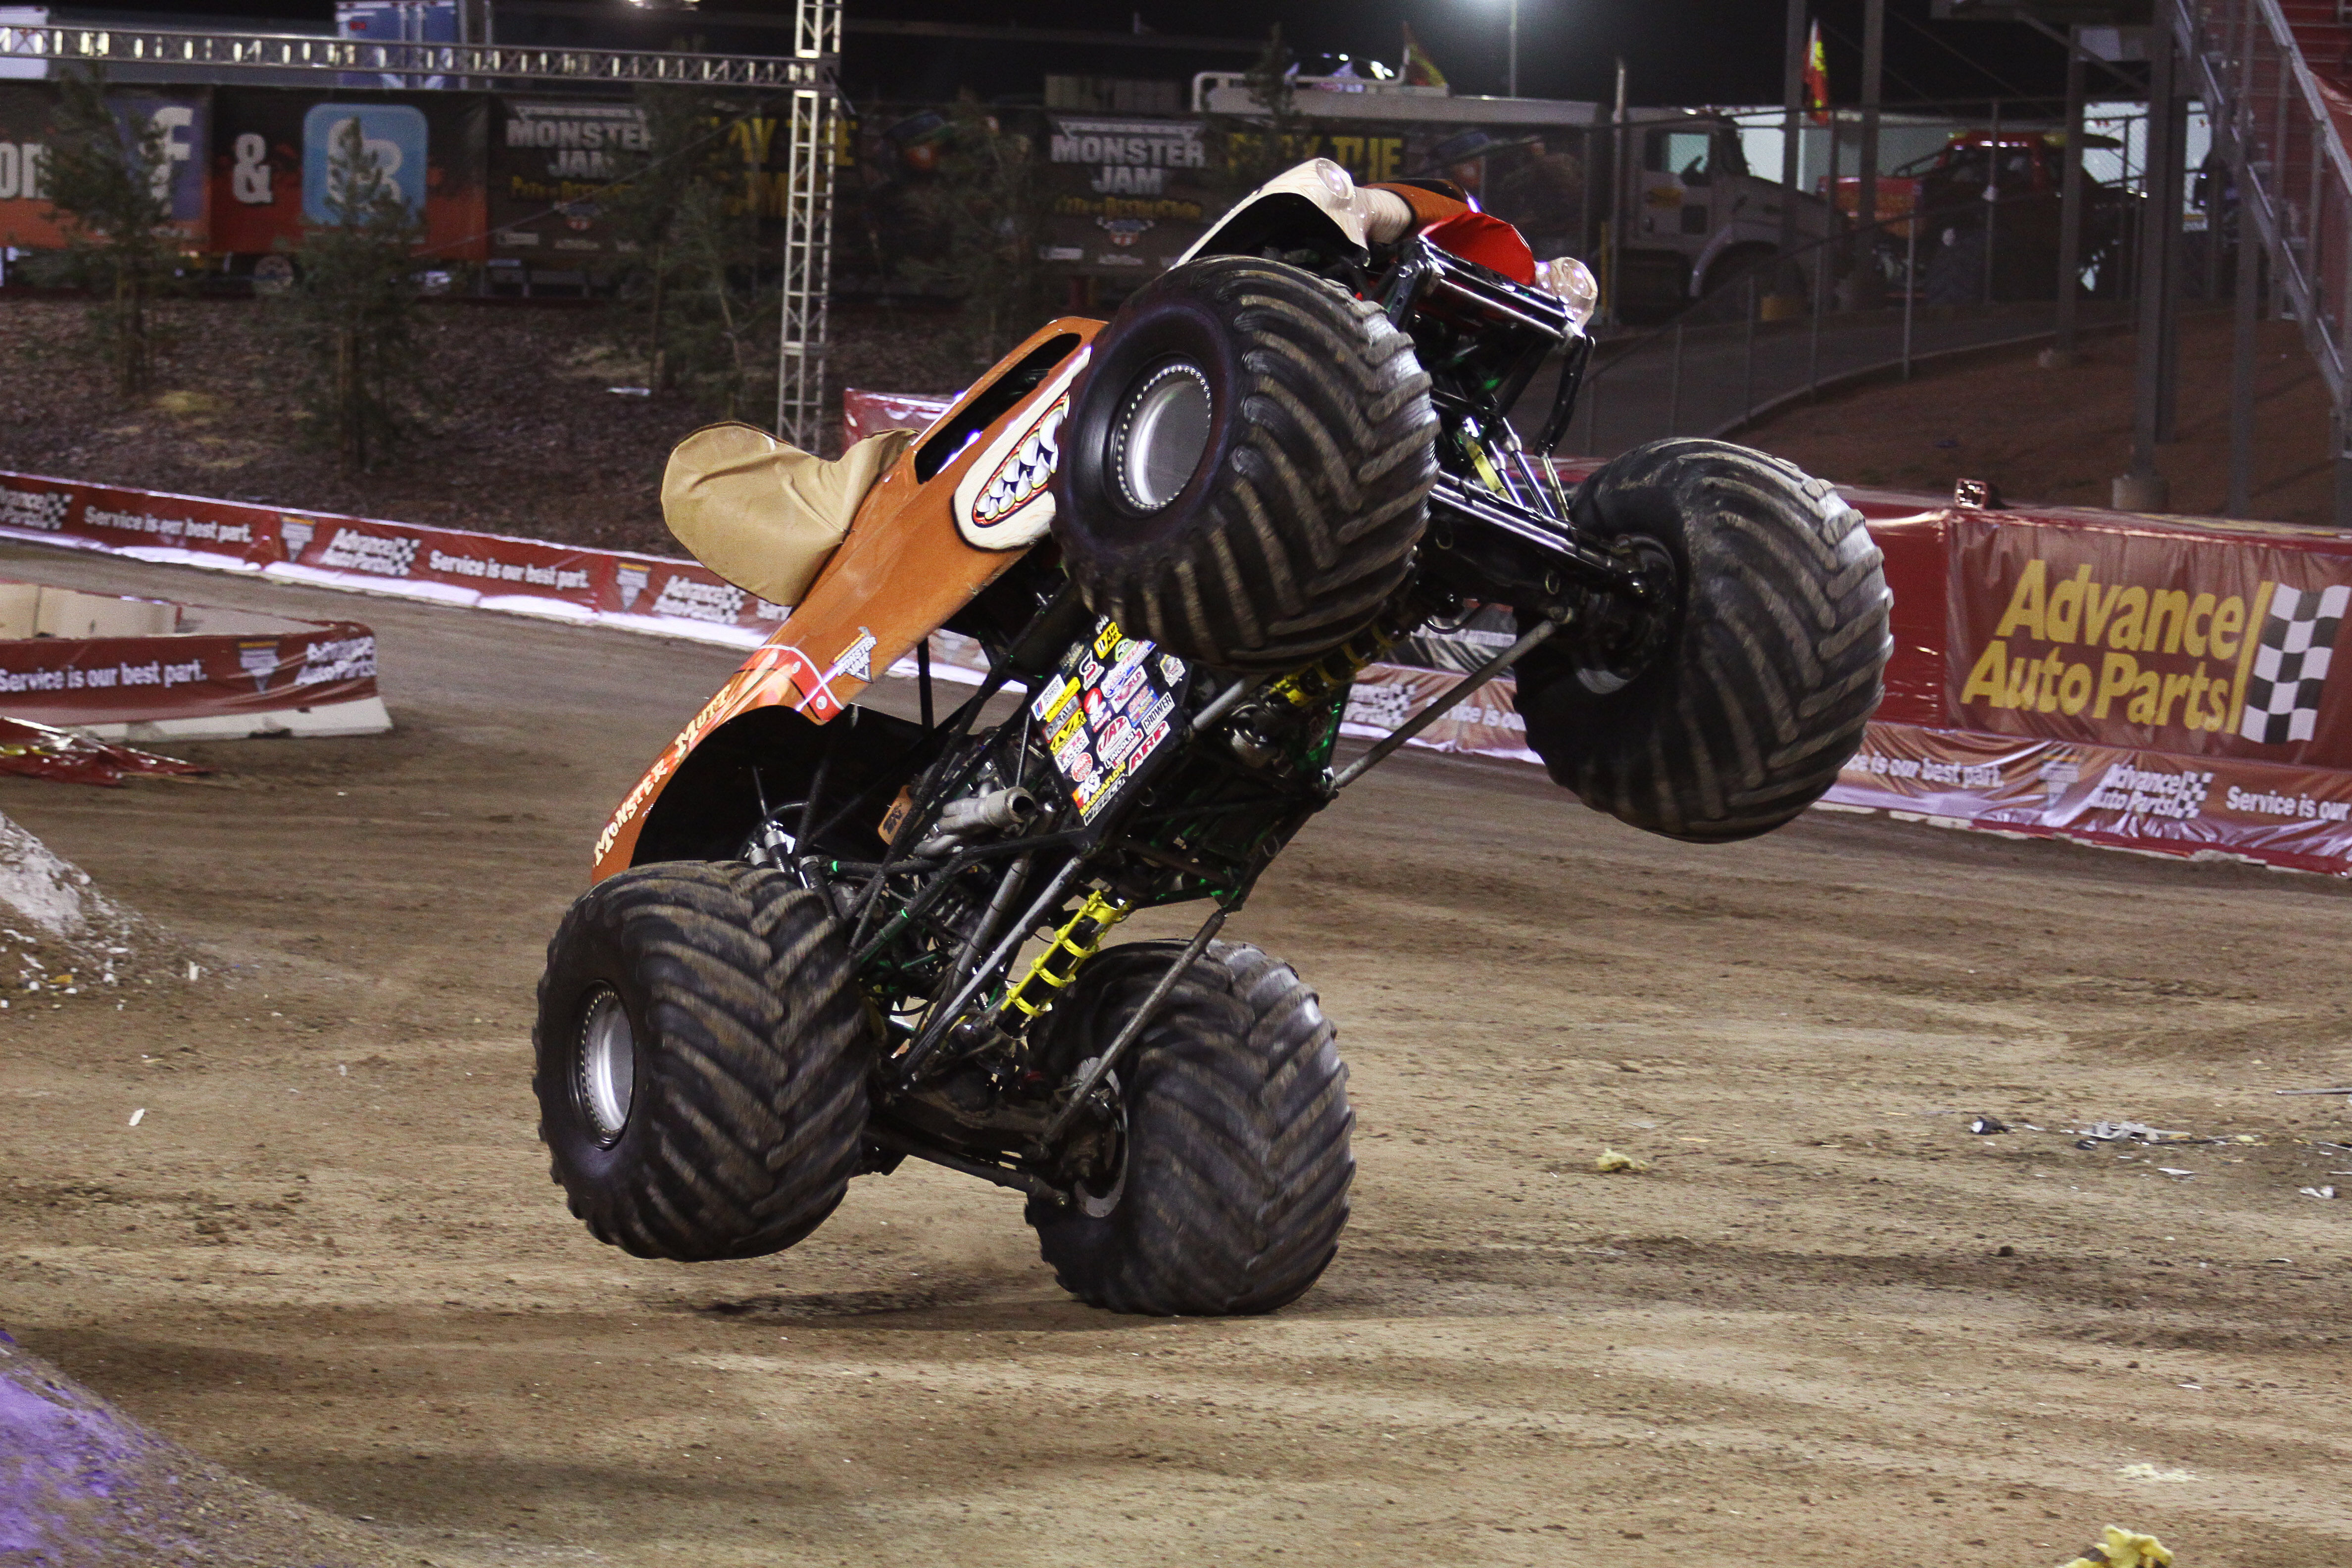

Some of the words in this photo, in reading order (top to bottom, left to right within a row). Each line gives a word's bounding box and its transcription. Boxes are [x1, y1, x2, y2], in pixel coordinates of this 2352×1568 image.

[1050, 134, 1207, 167] MONSTER
[232, 133, 273, 204] &
[1090, 166, 1164, 195] JAM
[84, 505, 143, 531] Service
[144, 513, 158, 533] is
[159, 519, 184, 536] our
[185, 517, 216, 539] best
[329, 528, 395, 558] Advance
[429, 549, 486, 577] Service
[487, 557, 501, 579] is
[501, 564, 525, 581] our
[525, 563, 556, 586] best
[1995, 559, 2245, 660] Advance
[0, 666, 64, 691] Service
[67, 664, 84, 688] is
[86, 668, 118, 688] our
[120, 661, 160, 686] best
[1960, 639, 2092, 716] Auto
[2092, 651, 2229, 732] Parts
[1143, 696, 1173, 730] CROWER
[1106, 729, 1134, 765] LINCOLN
[1130, 722, 1167, 771] ARP
[1870, 751, 1888, 775] is
[1888, 758, 1921, 778] our
[1921, 757, 1962, 784] best
[2101, 763, 2181, 795] Advance
[1079, 761, 1127, 817] MAGNAFLOW
[2226, 785, 2297, 816] Service
[2298, 792, 2317, 819] is
[2318, 800, 2352, 822] our
